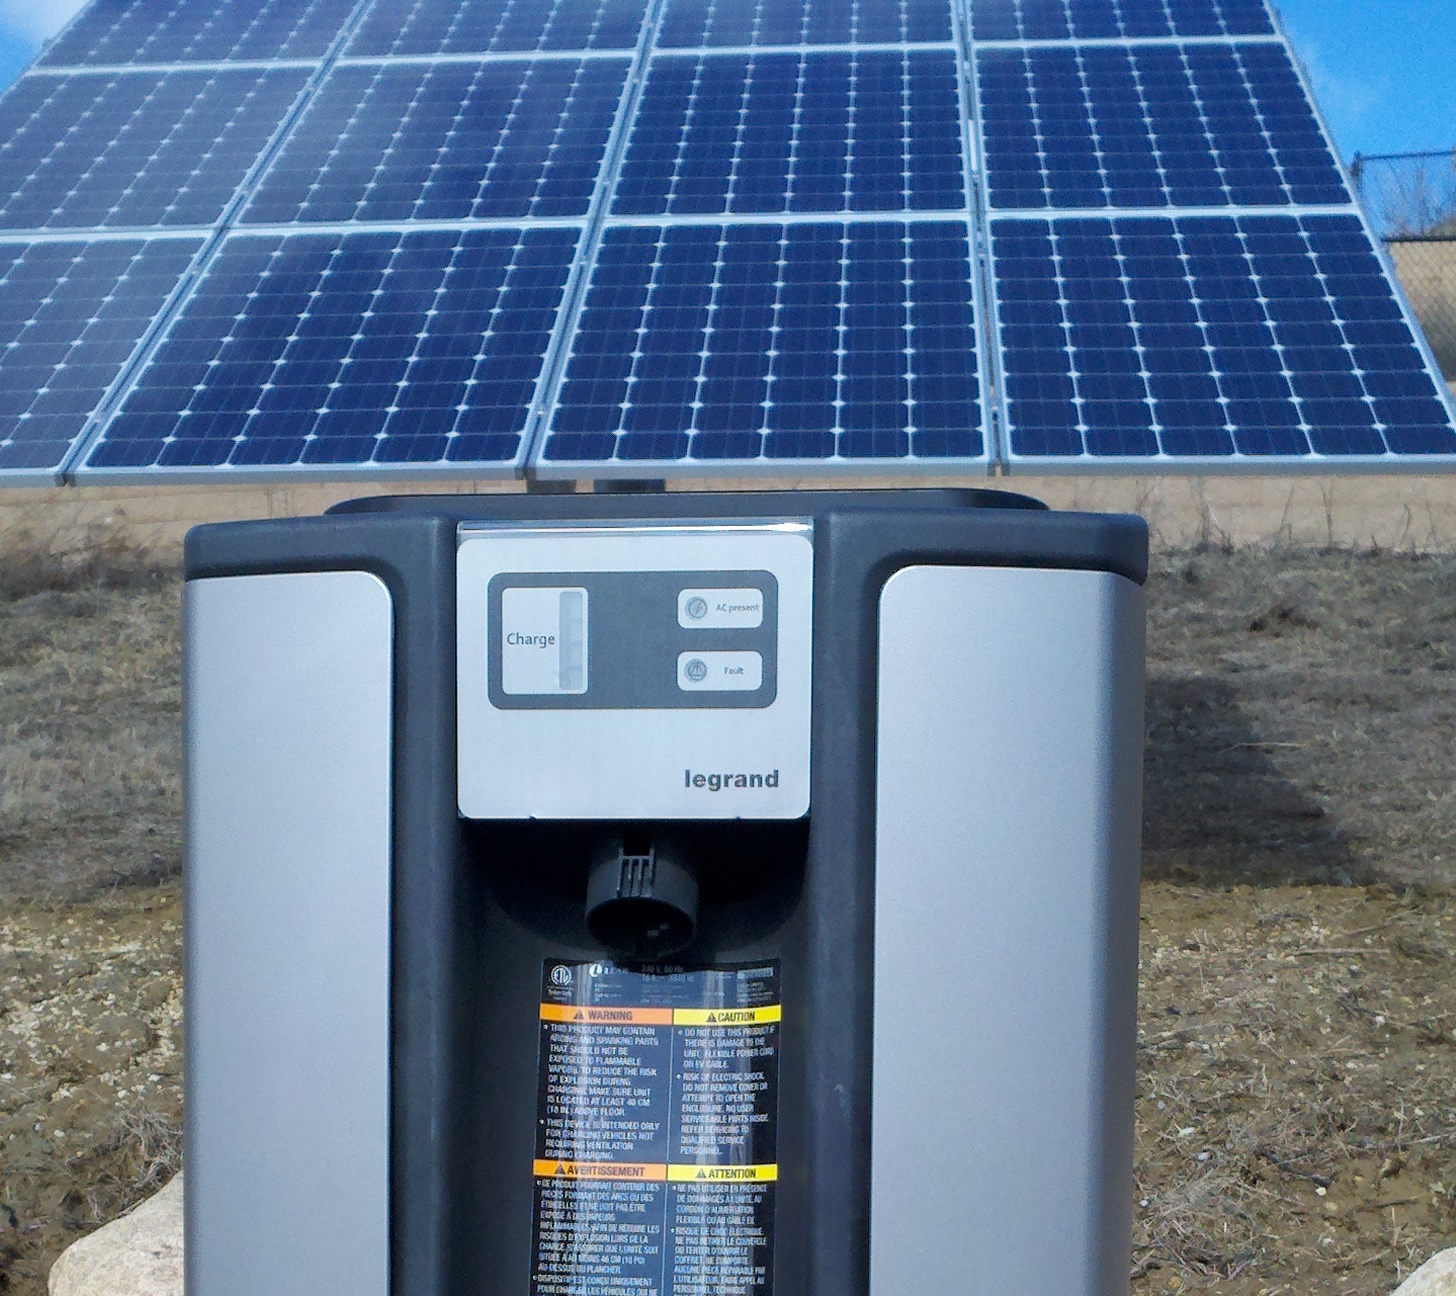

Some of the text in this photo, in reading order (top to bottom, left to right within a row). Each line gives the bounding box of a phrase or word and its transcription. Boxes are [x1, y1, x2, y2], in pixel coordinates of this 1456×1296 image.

[715, 603, 760, 614] AC present
[506, 632, 556, 648] Charge
[723, 666, 744, 675] Fault
[684, 769, 779, 792] legrand
[588, 1010, 633, 1020] WARNING
[718, 1011, 756, 1021] CAUTION
[550, 1023, 567, 1033] THIS
[605, 1026, 621, 1035] MAY
[622, 1026, 656, 1036] CONTAIN
[684, 1028, 696, 1037] DO
[696, 1028, 710, 1037] NOT
[711, 1028, 726, 1037] USE
[727, 1027, 742, 1037] THIS
[550, 1043, 568, 1053] THAT
[601, 1046, 617, 1055] NOT
[618, 1046, 629, 1055] BE
[581, 1065, 591, 1074] TO
[592, 1066, 622, 1075] REDUCE
[624, 1067, 638, 1076] THE
[639, 1067, 657, 1076] RISK
[547, 1074, 559, 1083] OF
[682, 1072, 700, 1081] RISK
[588, 1086, 611, 1096] MAKE
[633, 1088, 652, 1097] UNIT
[682, 1083, 693, 1092] DO
[694, 1083, 708, 1092] NOT
[546, 1095, 556, 1104] IS
[590, 1097, 600, 1106] AT
[601, 1097, 625, 1107] LEAST
[546, 1118, 564, 1127] THIS
[640, 1121, 661, 1131] ONLY
[566, 1165, 646, 1177] AVERTISSEMENT
[708, 1168, 757, 1179] ATTENTION
